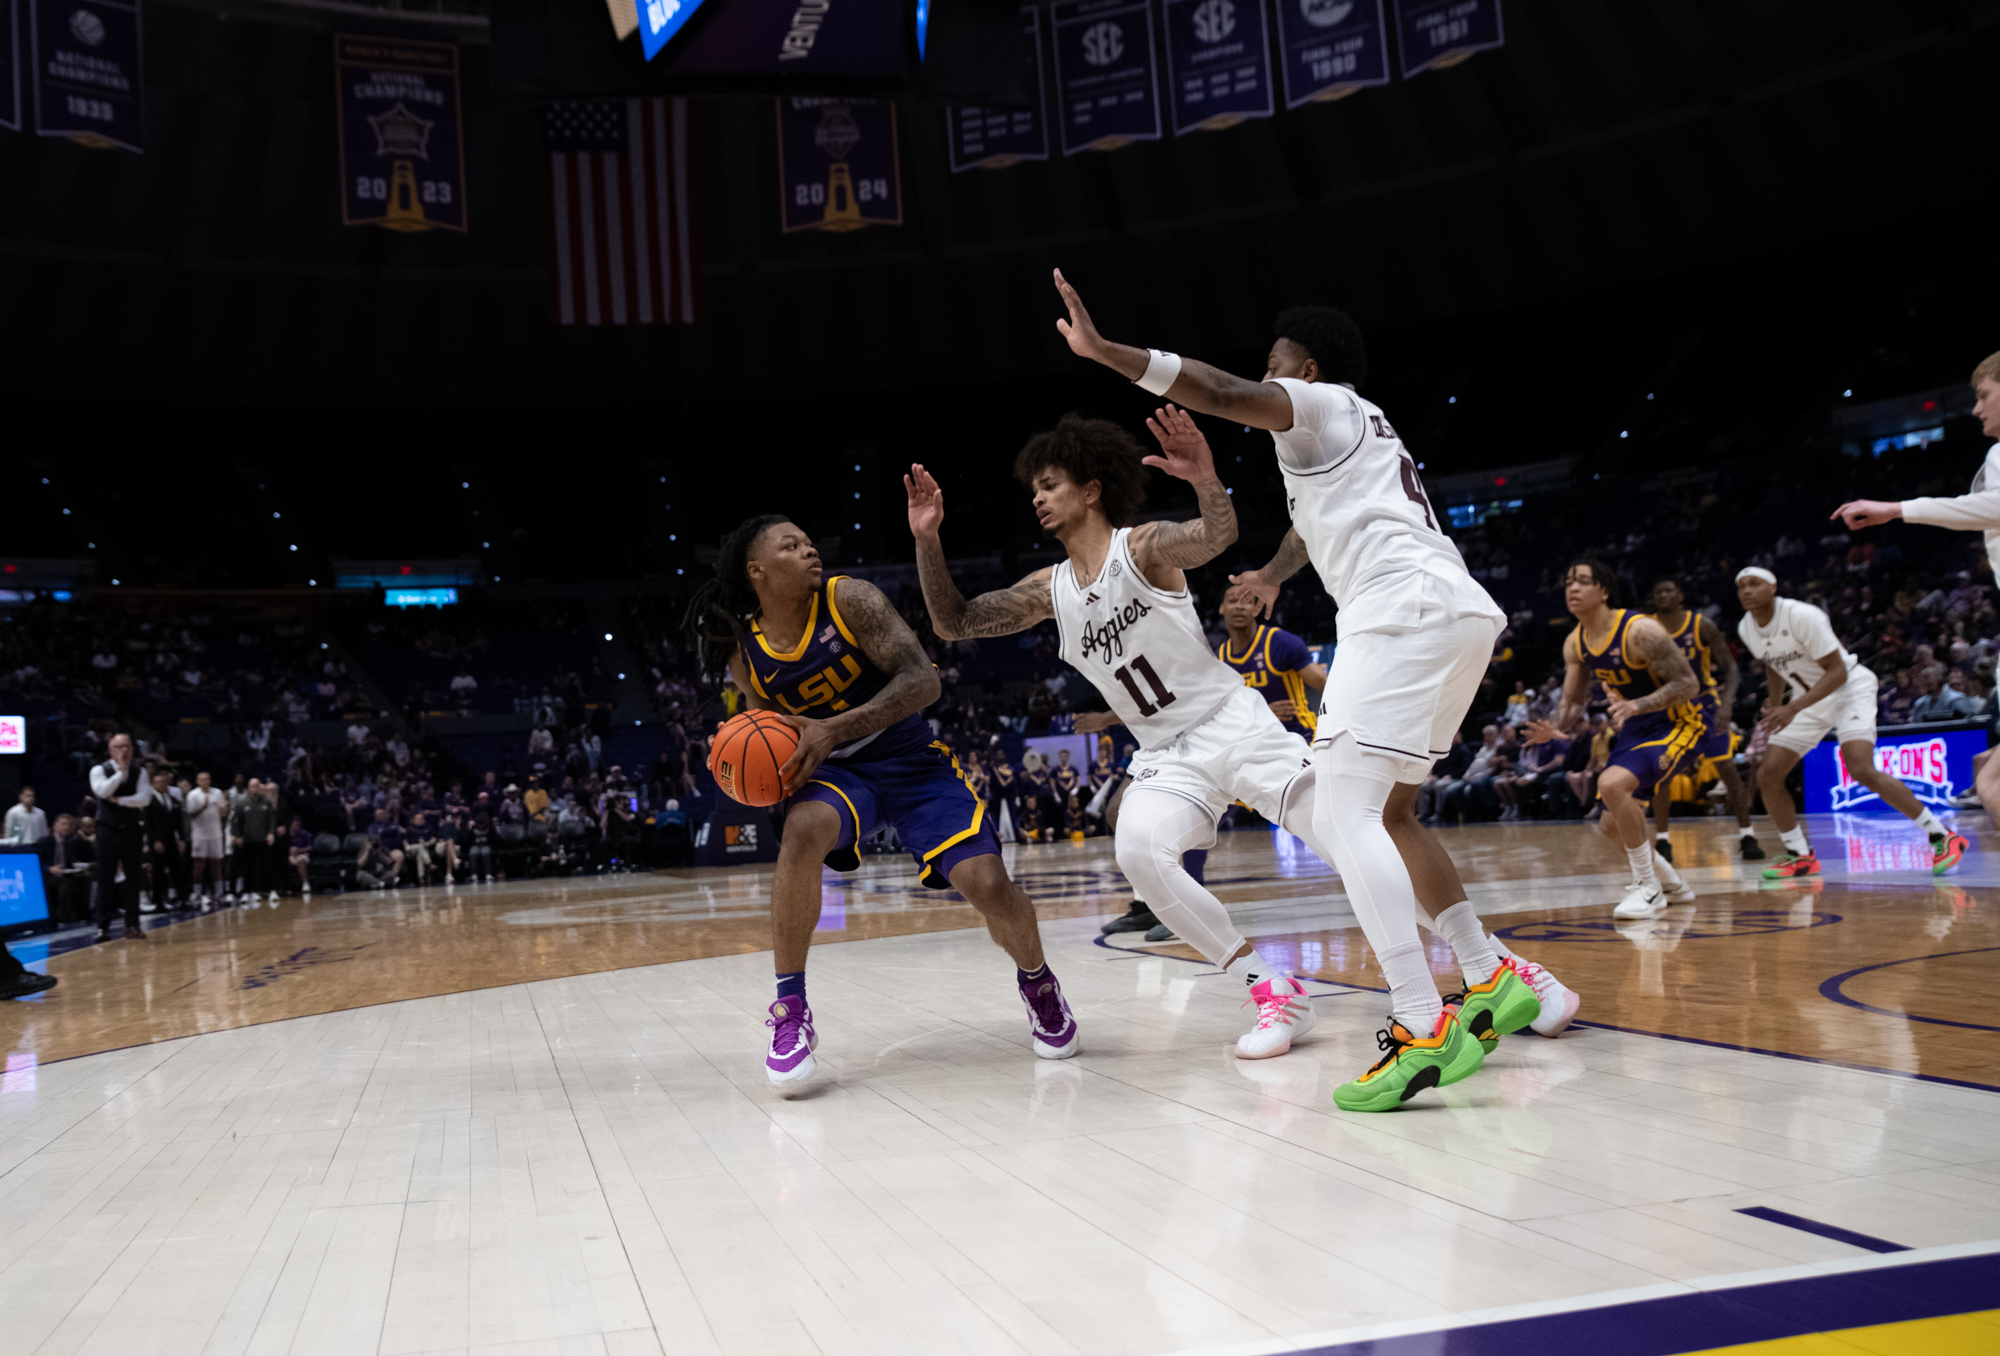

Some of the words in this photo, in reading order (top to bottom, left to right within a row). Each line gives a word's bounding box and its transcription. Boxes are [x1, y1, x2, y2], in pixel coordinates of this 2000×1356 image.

[1191, 0, 1237, 43] SEC
[1082, 22, 1125, 67] SEC
[48, 60, 130, 92] CHAMPIONS
[353, 83, 444, 107] CHAMPIONS
[356, 175, 387, 201] 20
[422, 179, 452, 205] 23
[795, 182, 824, 206] 20
[858, 177, 888, 202] 24
[1081, 598, 1152, 665] Aggies
[775, 653, 862, 716] LSU
[1114, 654, 1177, 718] 11
[1595, 668, 1632, 685] SU
